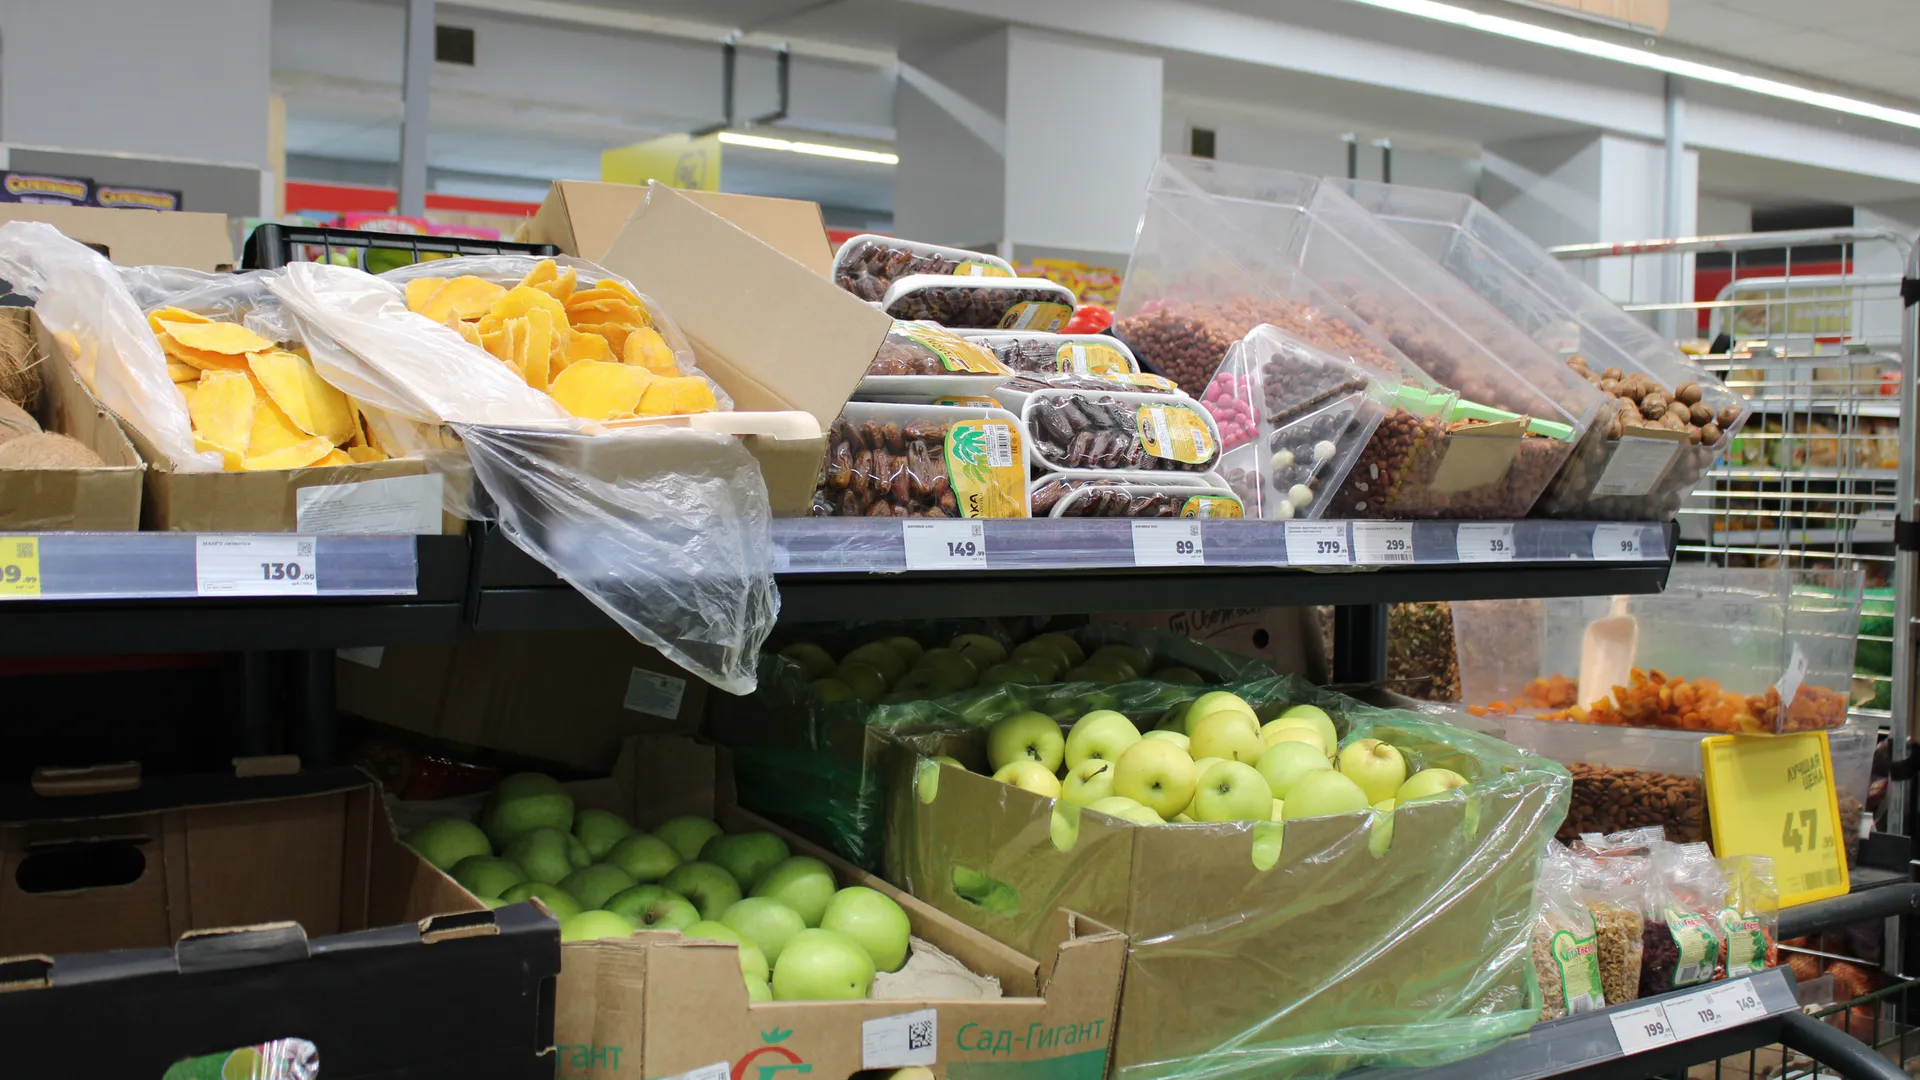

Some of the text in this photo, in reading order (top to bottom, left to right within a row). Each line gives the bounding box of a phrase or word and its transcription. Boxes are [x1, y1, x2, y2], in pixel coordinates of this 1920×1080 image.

[1787, 753, 1823, 784] ЛУЧШАЯ
[1802, 769, 1826, 792] ЦЕНА
[956, 1019, 1106, 1056] Сад-Гигант
